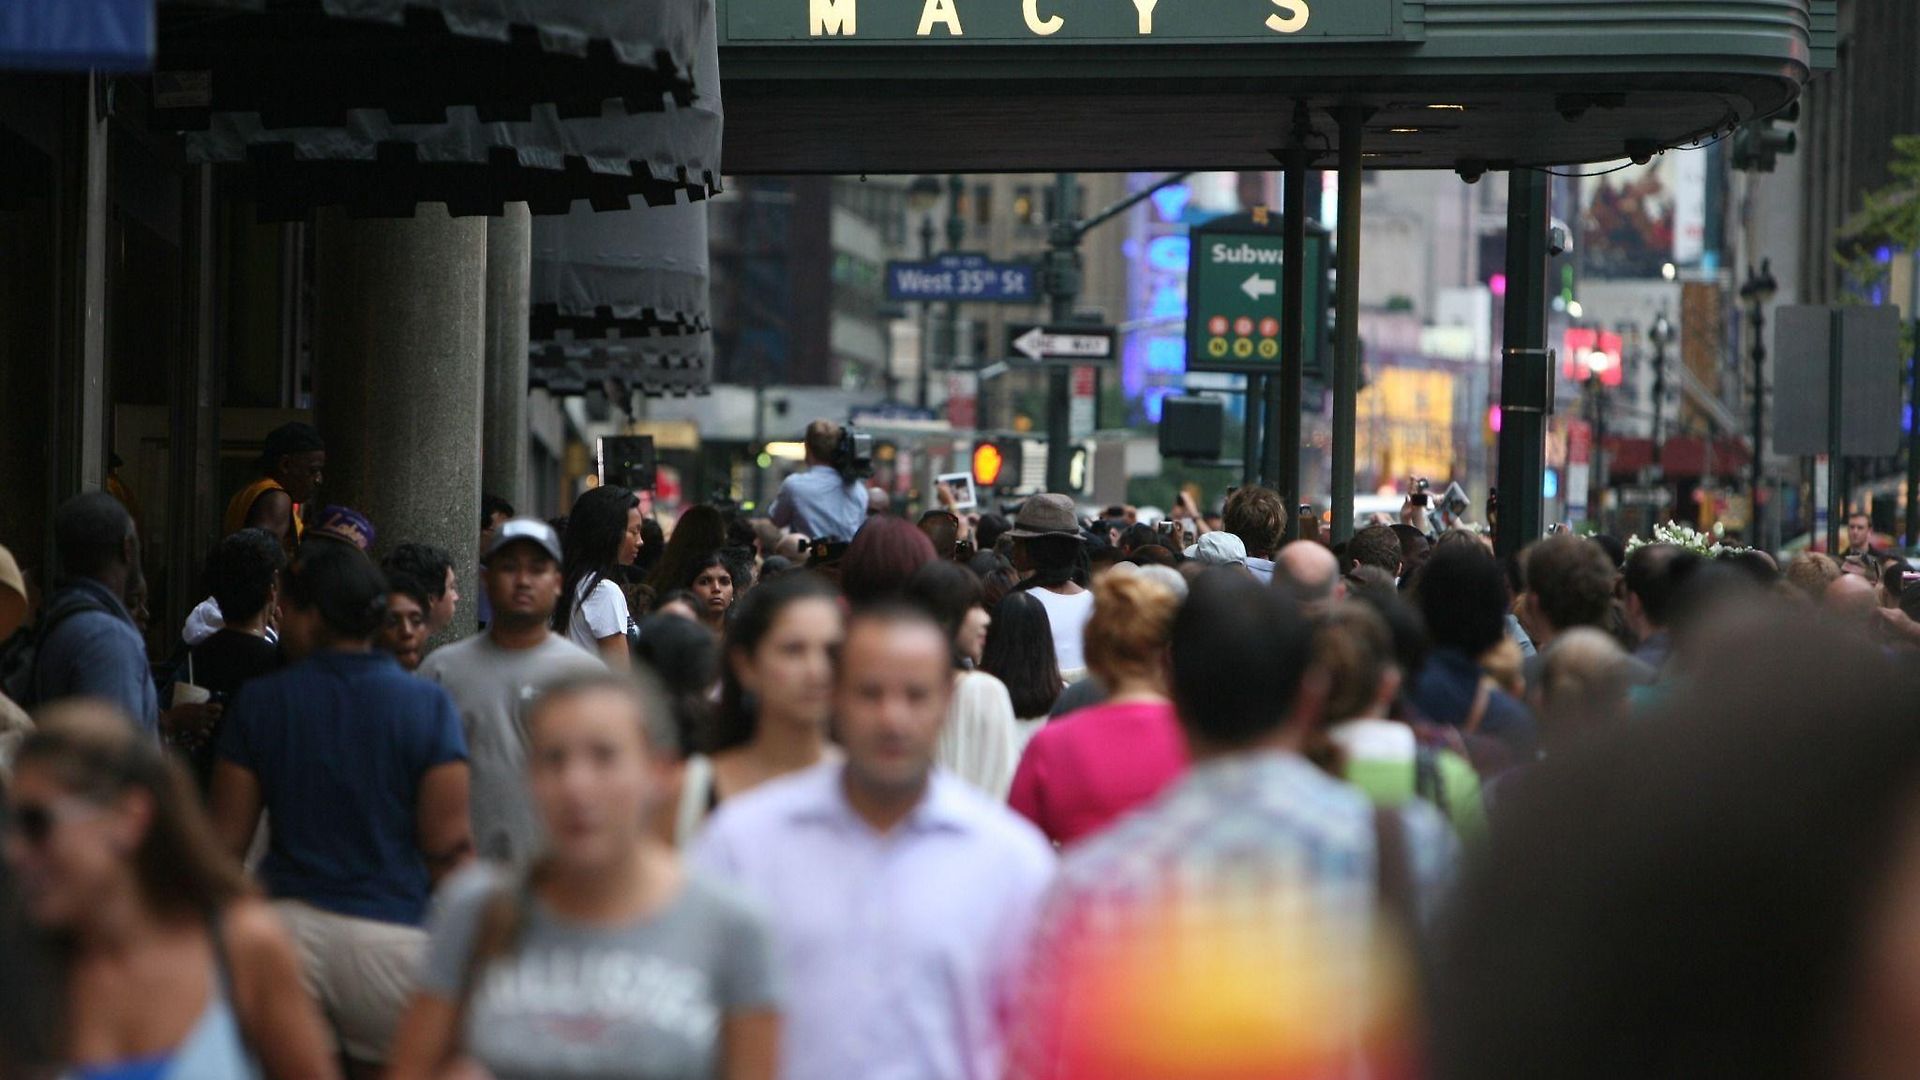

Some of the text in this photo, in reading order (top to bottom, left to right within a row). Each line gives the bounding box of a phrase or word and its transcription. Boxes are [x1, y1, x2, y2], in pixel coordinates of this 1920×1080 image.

[1212, 243, 1286, 265] Subw
[897, 269, 1026, 294] West 35th St
